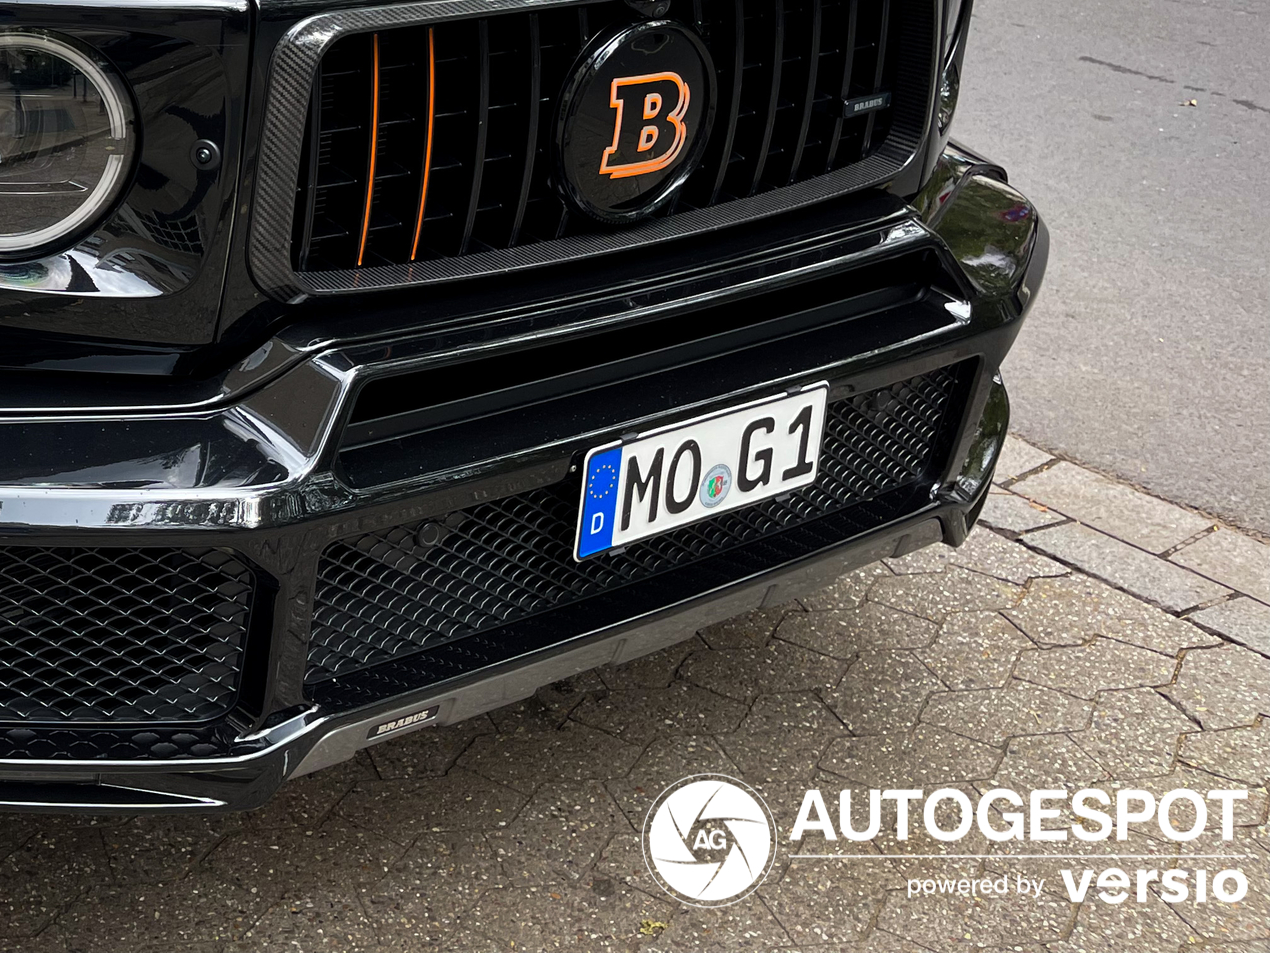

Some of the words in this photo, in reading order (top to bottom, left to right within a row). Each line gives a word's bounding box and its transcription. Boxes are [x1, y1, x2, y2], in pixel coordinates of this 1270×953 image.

[853, 97, 883, 112] BRABUS
[599, 71, 691, 180] B
[620, 439, 703, 532] MO
[737, 404, 815, 493] G1
[590, 511, 605, 536] D
[376, 709, 430, 735] BRABUS
